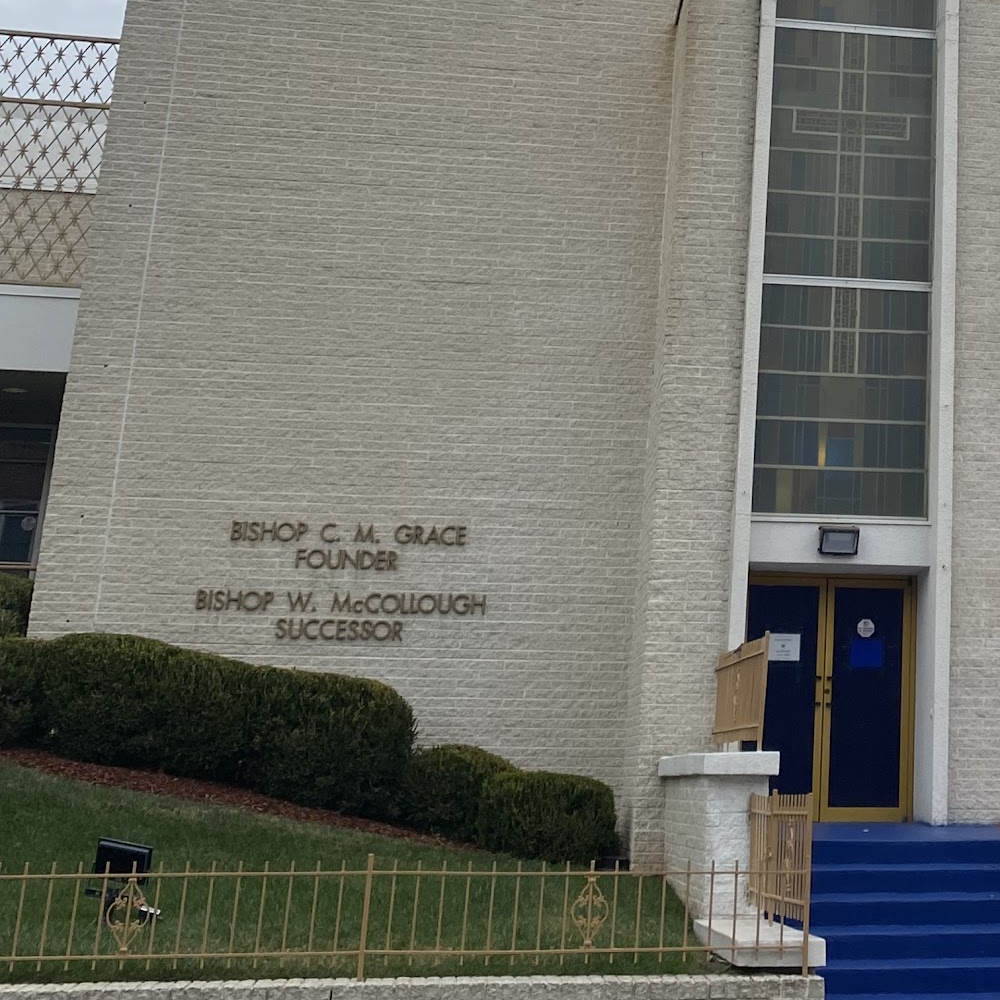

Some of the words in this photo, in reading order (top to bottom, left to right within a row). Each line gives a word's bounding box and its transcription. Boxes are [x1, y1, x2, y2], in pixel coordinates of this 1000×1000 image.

[230, 520, 308, 542] BISHOP
[320, 522, 341, 543] C.
[353, 522, 380, 544] M.
[394, 524, 467, 546] GRACE
[295, 549, 397, 571] FOUNDER
[195, 589, 274, 612] BISHOP
[287, 591, 317, 612] W.
[330, 591, 487, 616] McCOLLOUGH
[275, 618, 403, 641] SUCCESSOR
